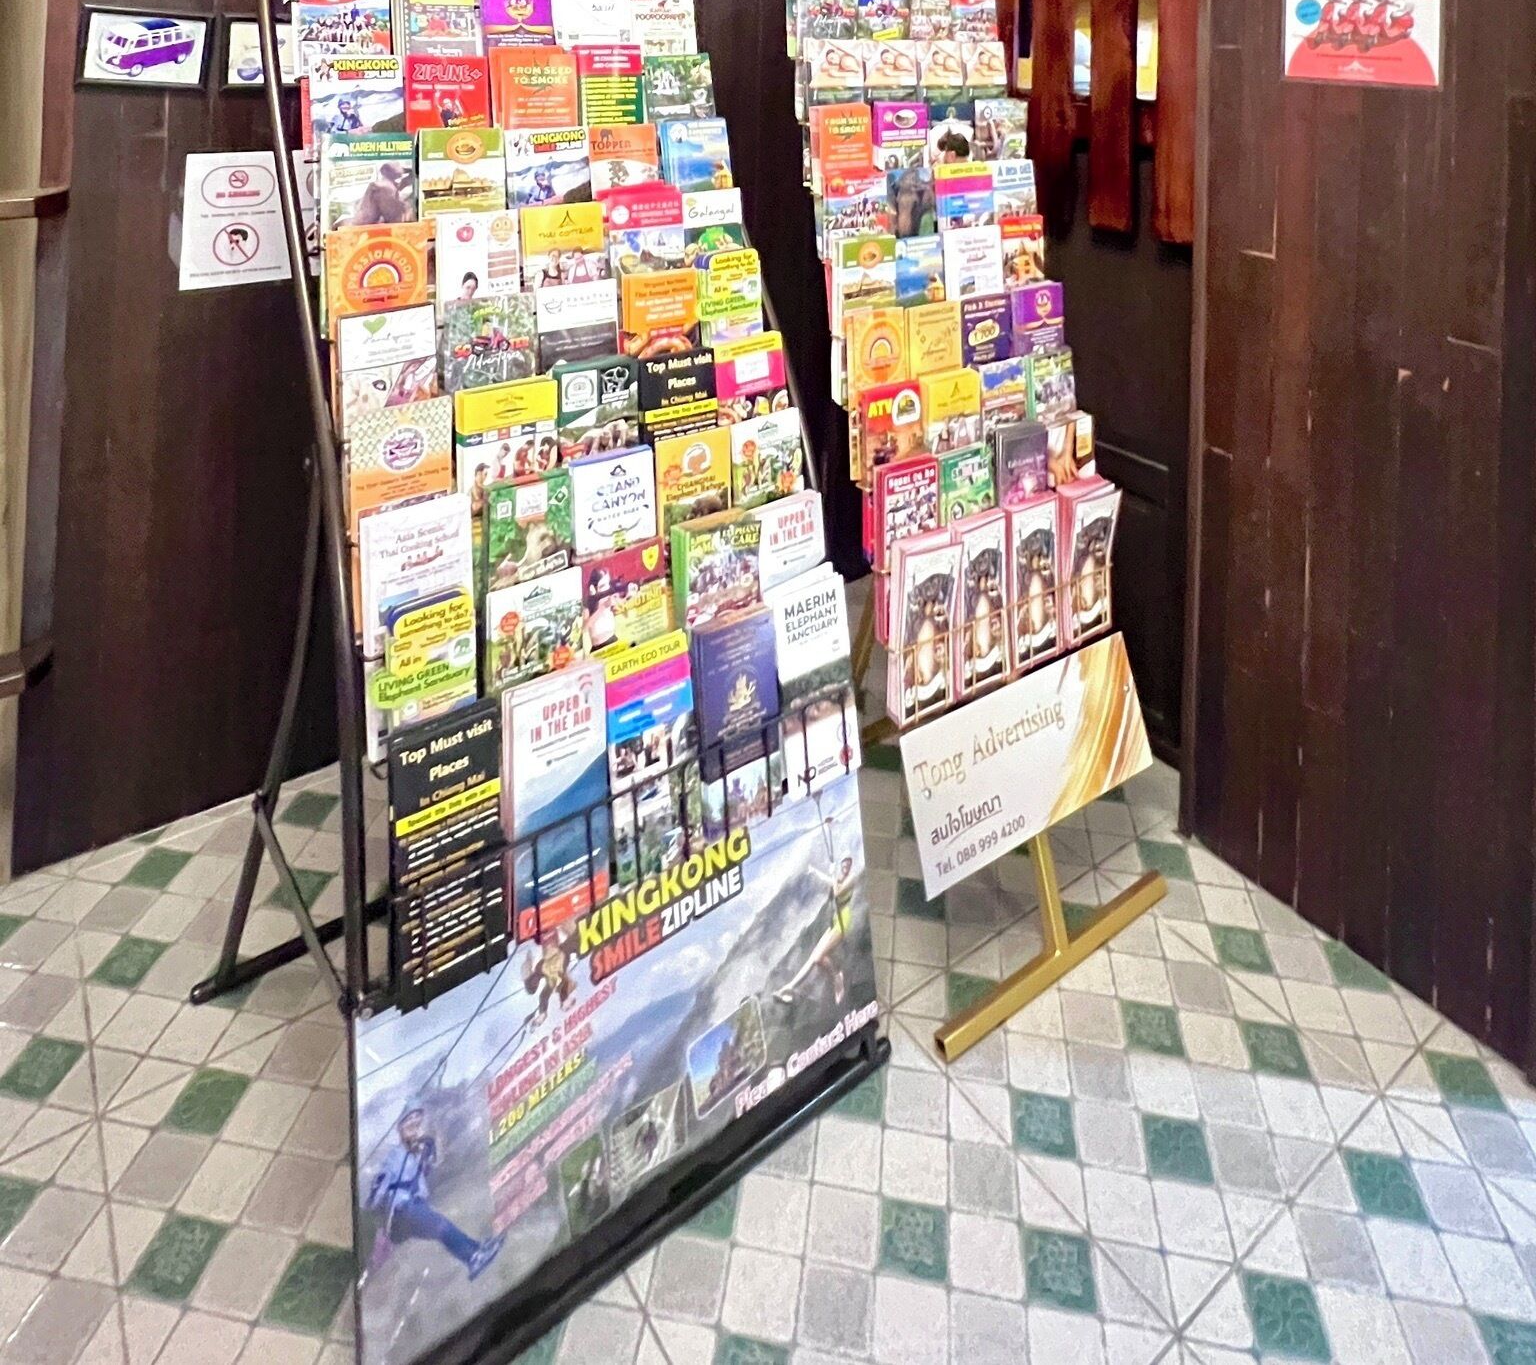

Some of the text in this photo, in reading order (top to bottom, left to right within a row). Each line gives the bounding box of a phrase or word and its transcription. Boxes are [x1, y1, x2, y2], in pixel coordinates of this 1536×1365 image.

[332, 58, 399, 72] KINGKONG
[509, 66, 573, 75] FROM SEED
[530, 76, 569, 85] SMOKE
[349, 141, 376, 153] KAREN
[529, 129, 586, 145] KINGKONG
[688, 202, 734, 221] Galangal
[715, 256, 742, 265] Looking
[646, 362, 666, 374] Top
[667, 356, 692, 370] Must
[667, 376, 697, 389] Places
[867, 397, 893, 418] ATV
[778, 510, 806, 529] UPPER
[782, 526, 798, 542] THE
[380, 548, 399, 559] Thai
[400, 539, 433, 554] Cooking
[404, 602, 465, 628] Looking for
[784, 588, 837, 621] MAERIM
[399, 620, 443, 639] something
[453, 609, 469, 620] do?
[785, 603, 838, 633] ELEPHANT
[787, 615, 839, 645] SANCTUARY
[399, 655, 422, 670] All in
[610, 657, 639, 676] EARTH
[640, 649, 658, 664] ECO
[659, 639, 681, 655] TOUR
[378, 662, 449, 692] LIVING GREEN
[378, 666, 472, 703] Elephant Sanctuary
[542, 693, 580, 721] UPPER
[399, 718, 494, 766] Top Must visit
[530, 725, 542, 744] IN
[547, 714, 569, 737] THE
[913, 699, 1066, 790] Tong Advertising
[429, 755, 470, 782] Places
[936, 814, 1026, 877] Tel. 088 999 4200
[577, 825, 751, 956] KINGKONG
[591, 865, 742, 983] SMILE ZIPLINE
